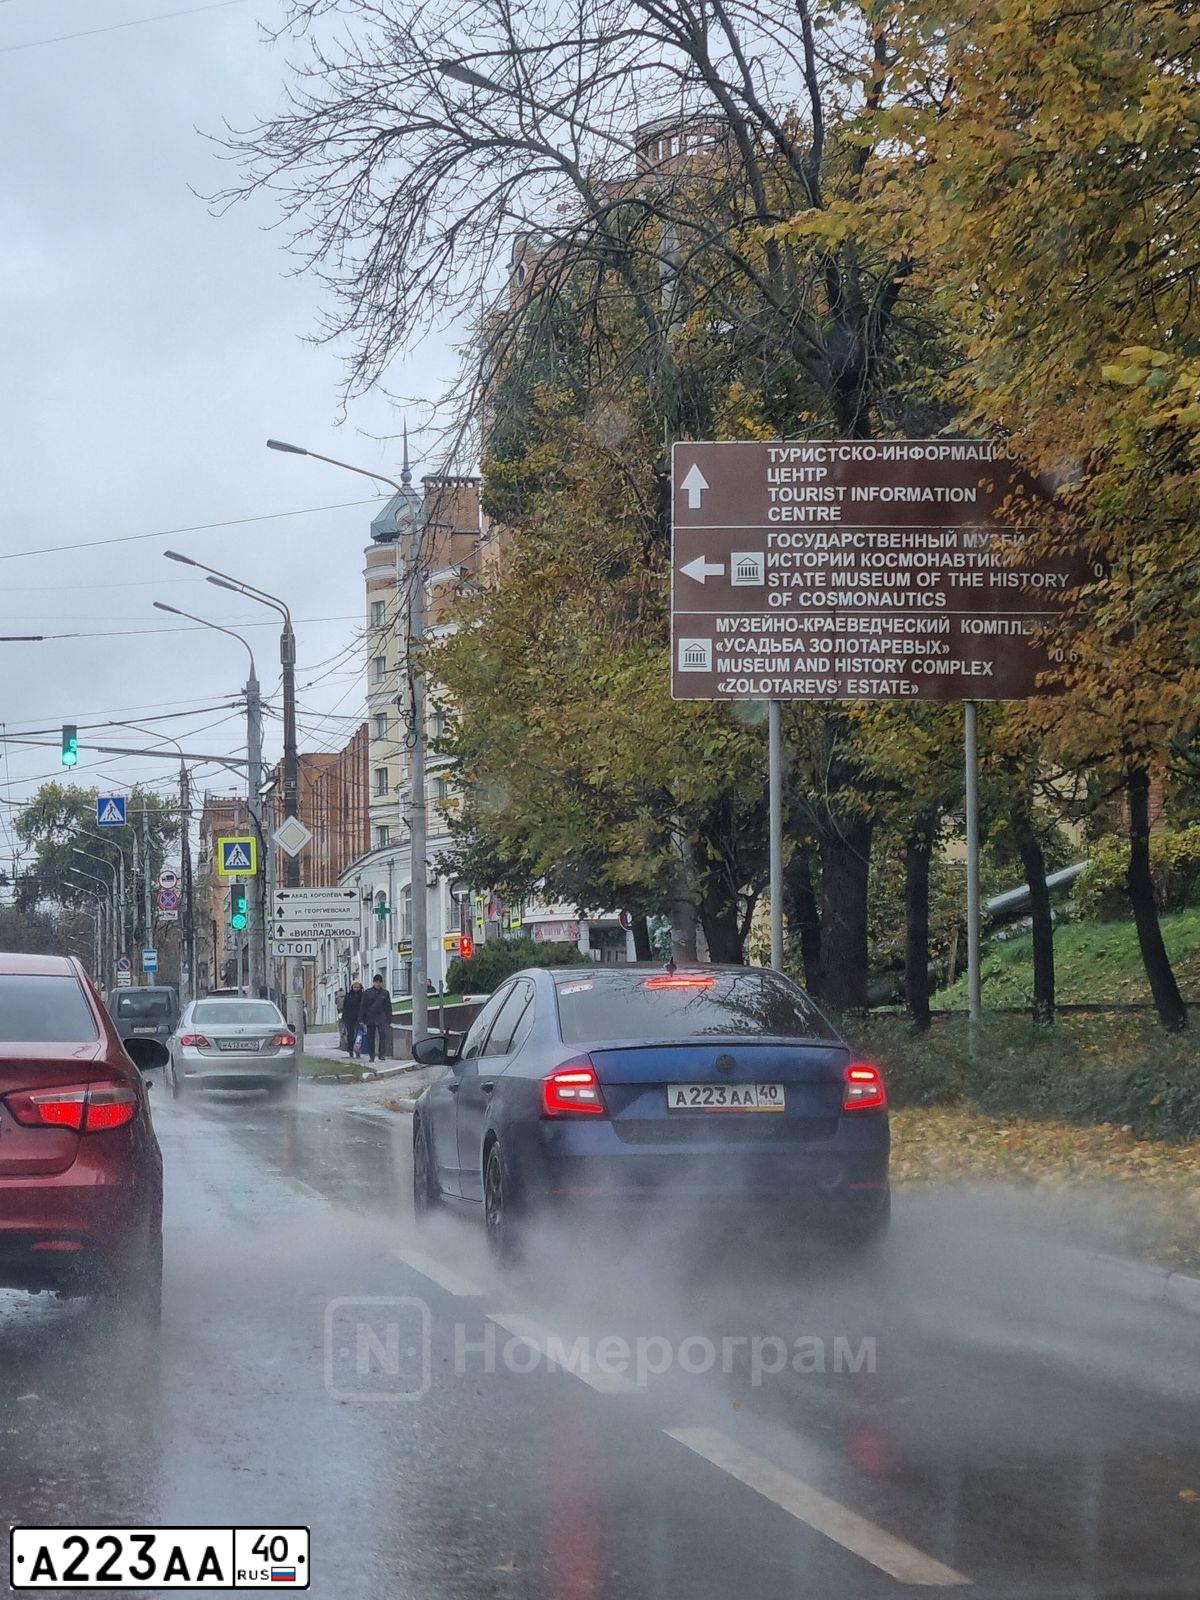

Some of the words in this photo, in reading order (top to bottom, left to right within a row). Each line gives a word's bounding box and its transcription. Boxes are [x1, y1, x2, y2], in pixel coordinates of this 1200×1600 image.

[767, 467, 828, 484] ЦЕНТР
[768, 487, 847, 502] TOURIST
[851, 487, 977, 502] INFORMATION
[768, 506, 841, 521] CENTRE
[767, 530, 957, 550] ГОСУДАРСТВЕННЫЙ
[767, 553, 855, 568] ИСТОРИИ
[768, 572, 826, 587] STATE
[831, 572, 911, 587] MUSEUM
[916, 572, 941, 587] OF
[948, 573, 985, 587] THE
[989, 573, 1070, 588] HISTORY
[768, 592, 792, 607] OF
[799, 592, 947, 607] COSMONAUTICS
[715, 615, 950, 634] МУЗЕЙНО-КРАЕВЕДЧЕСКИЙ
[715, 638, 805, 655] «УСАДЬБА
[809, 639, 950, 656] ЗОЛОТАРЕВЫХ»
[716, 658, 790, 673] MUSEUM
[794, 658, 831, 673] AND
[835, 659, 906, 674] HISTORY
[911, 660, 994, 675] COMPLEX
[847, 680, 919, 695] ESTATE»
[289, 929, 356, 937] «ВИЛЛАДЖИО»
[277, 943, 312, 954] СТОП
[676, 1087, 754, 1105] А223АА
[759, 1086, 777, 1099] 40
